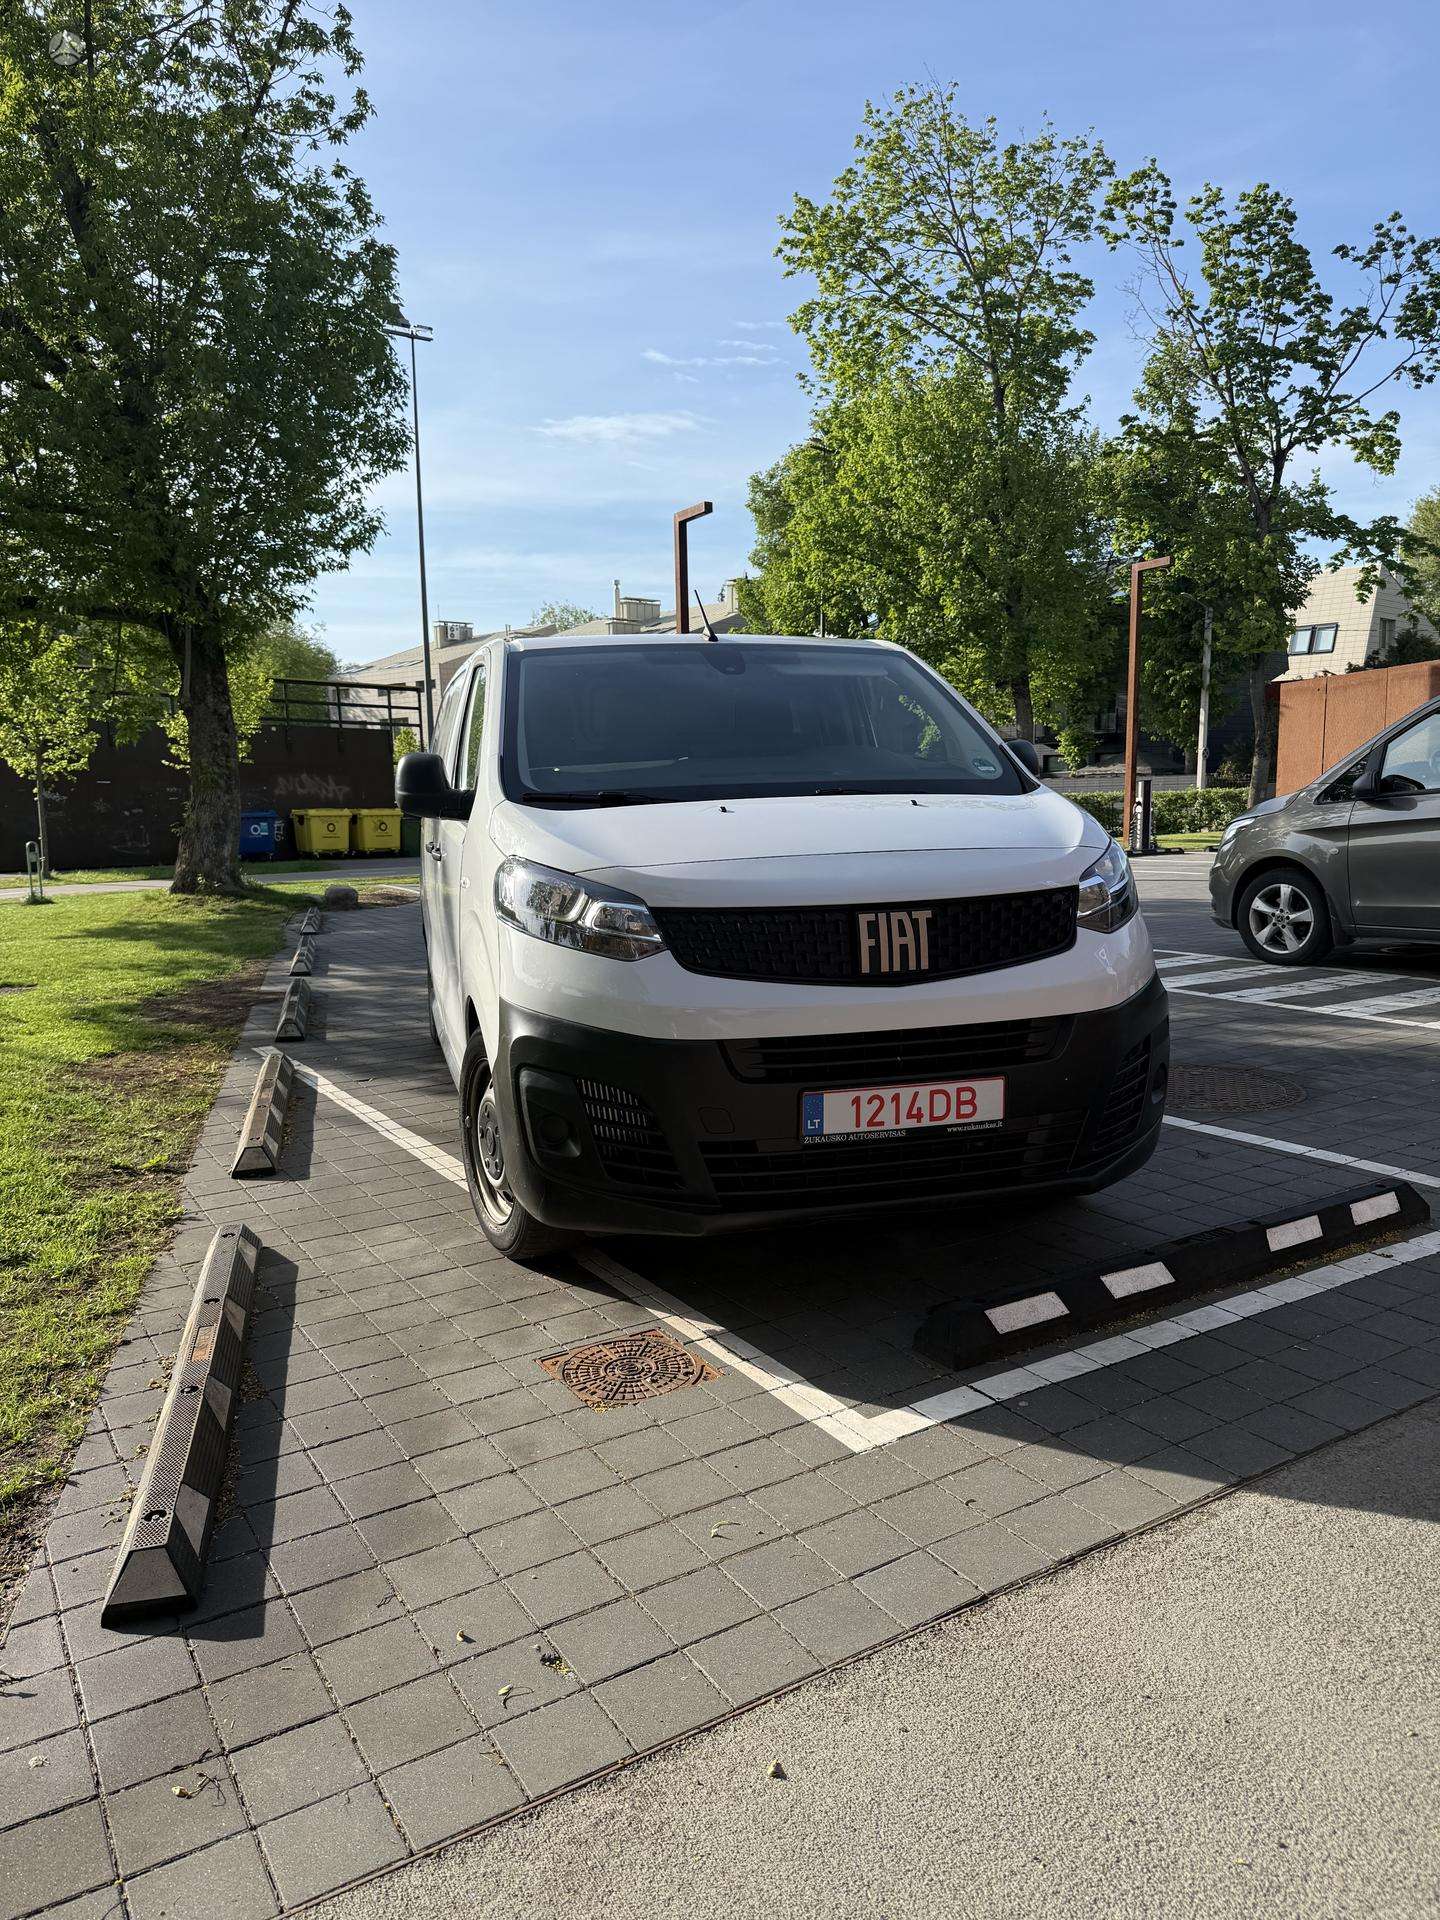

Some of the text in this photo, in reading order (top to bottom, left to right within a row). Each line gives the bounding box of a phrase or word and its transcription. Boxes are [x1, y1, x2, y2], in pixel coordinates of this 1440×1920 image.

[858, 910, 932, 973] FIAT
[851, 1086, 978, 1128] 1214DB
[807, 1119, 820, 1129] LT
[848, 1129, 906, 1141] AUTOSERVISAS
